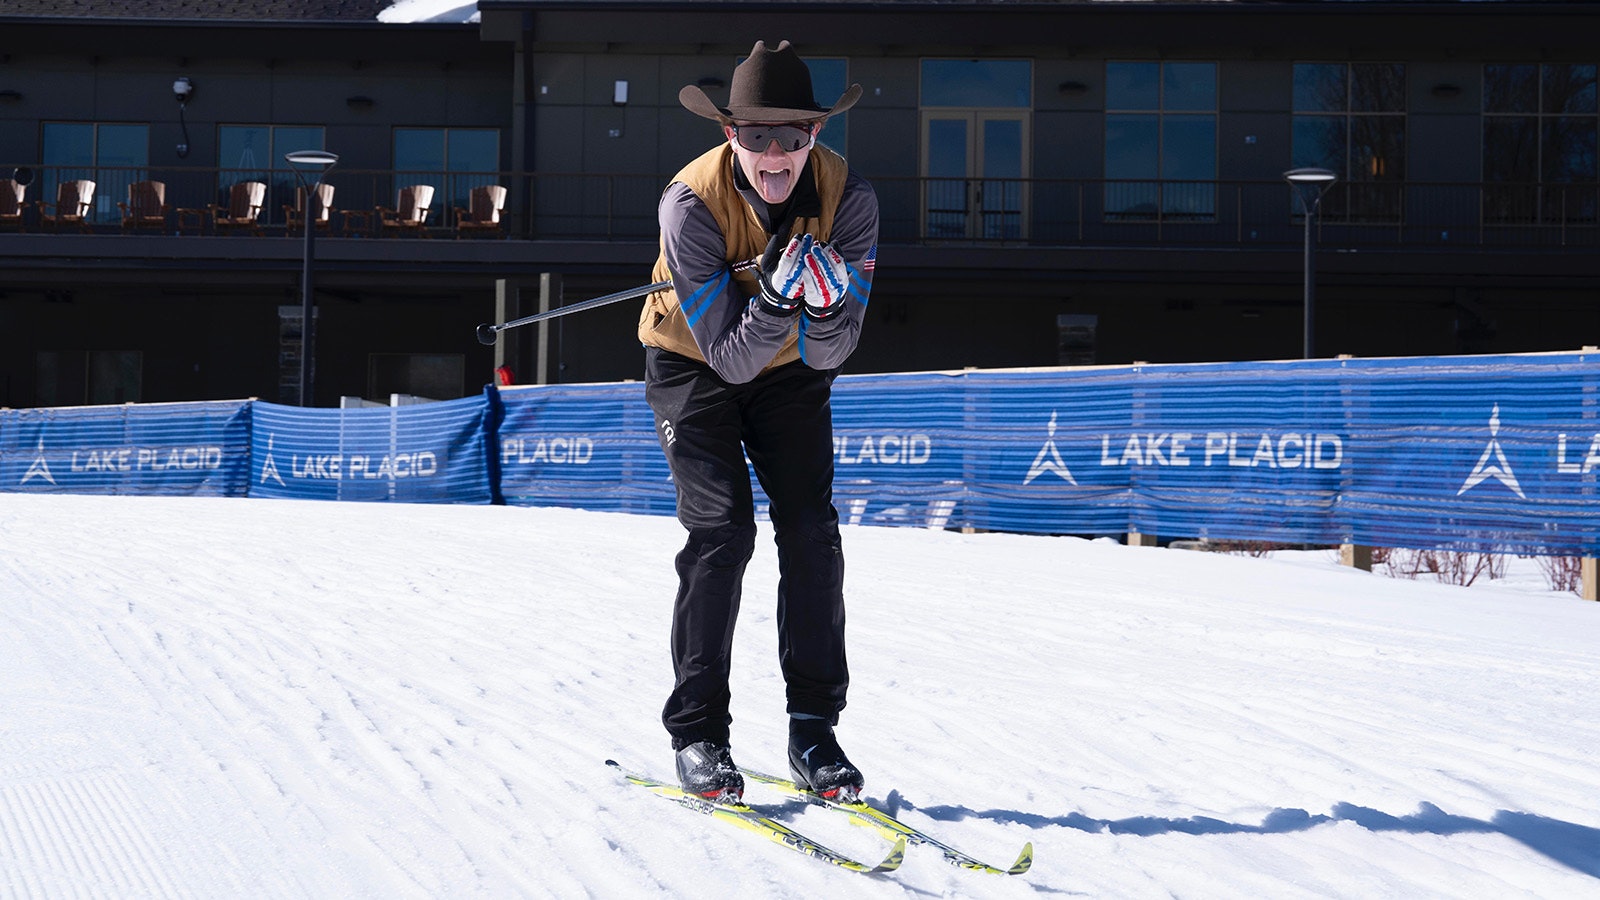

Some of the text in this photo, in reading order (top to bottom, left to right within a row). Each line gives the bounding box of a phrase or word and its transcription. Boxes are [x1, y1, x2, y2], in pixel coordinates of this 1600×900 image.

[71, 447, 222, 472] LAKE PLACID
[503, 438, 593, 464] PLACID
[1100, 432, 1343, 469] LAKE PLACID
[292, 451, 437, 479] LAKE PLACID
